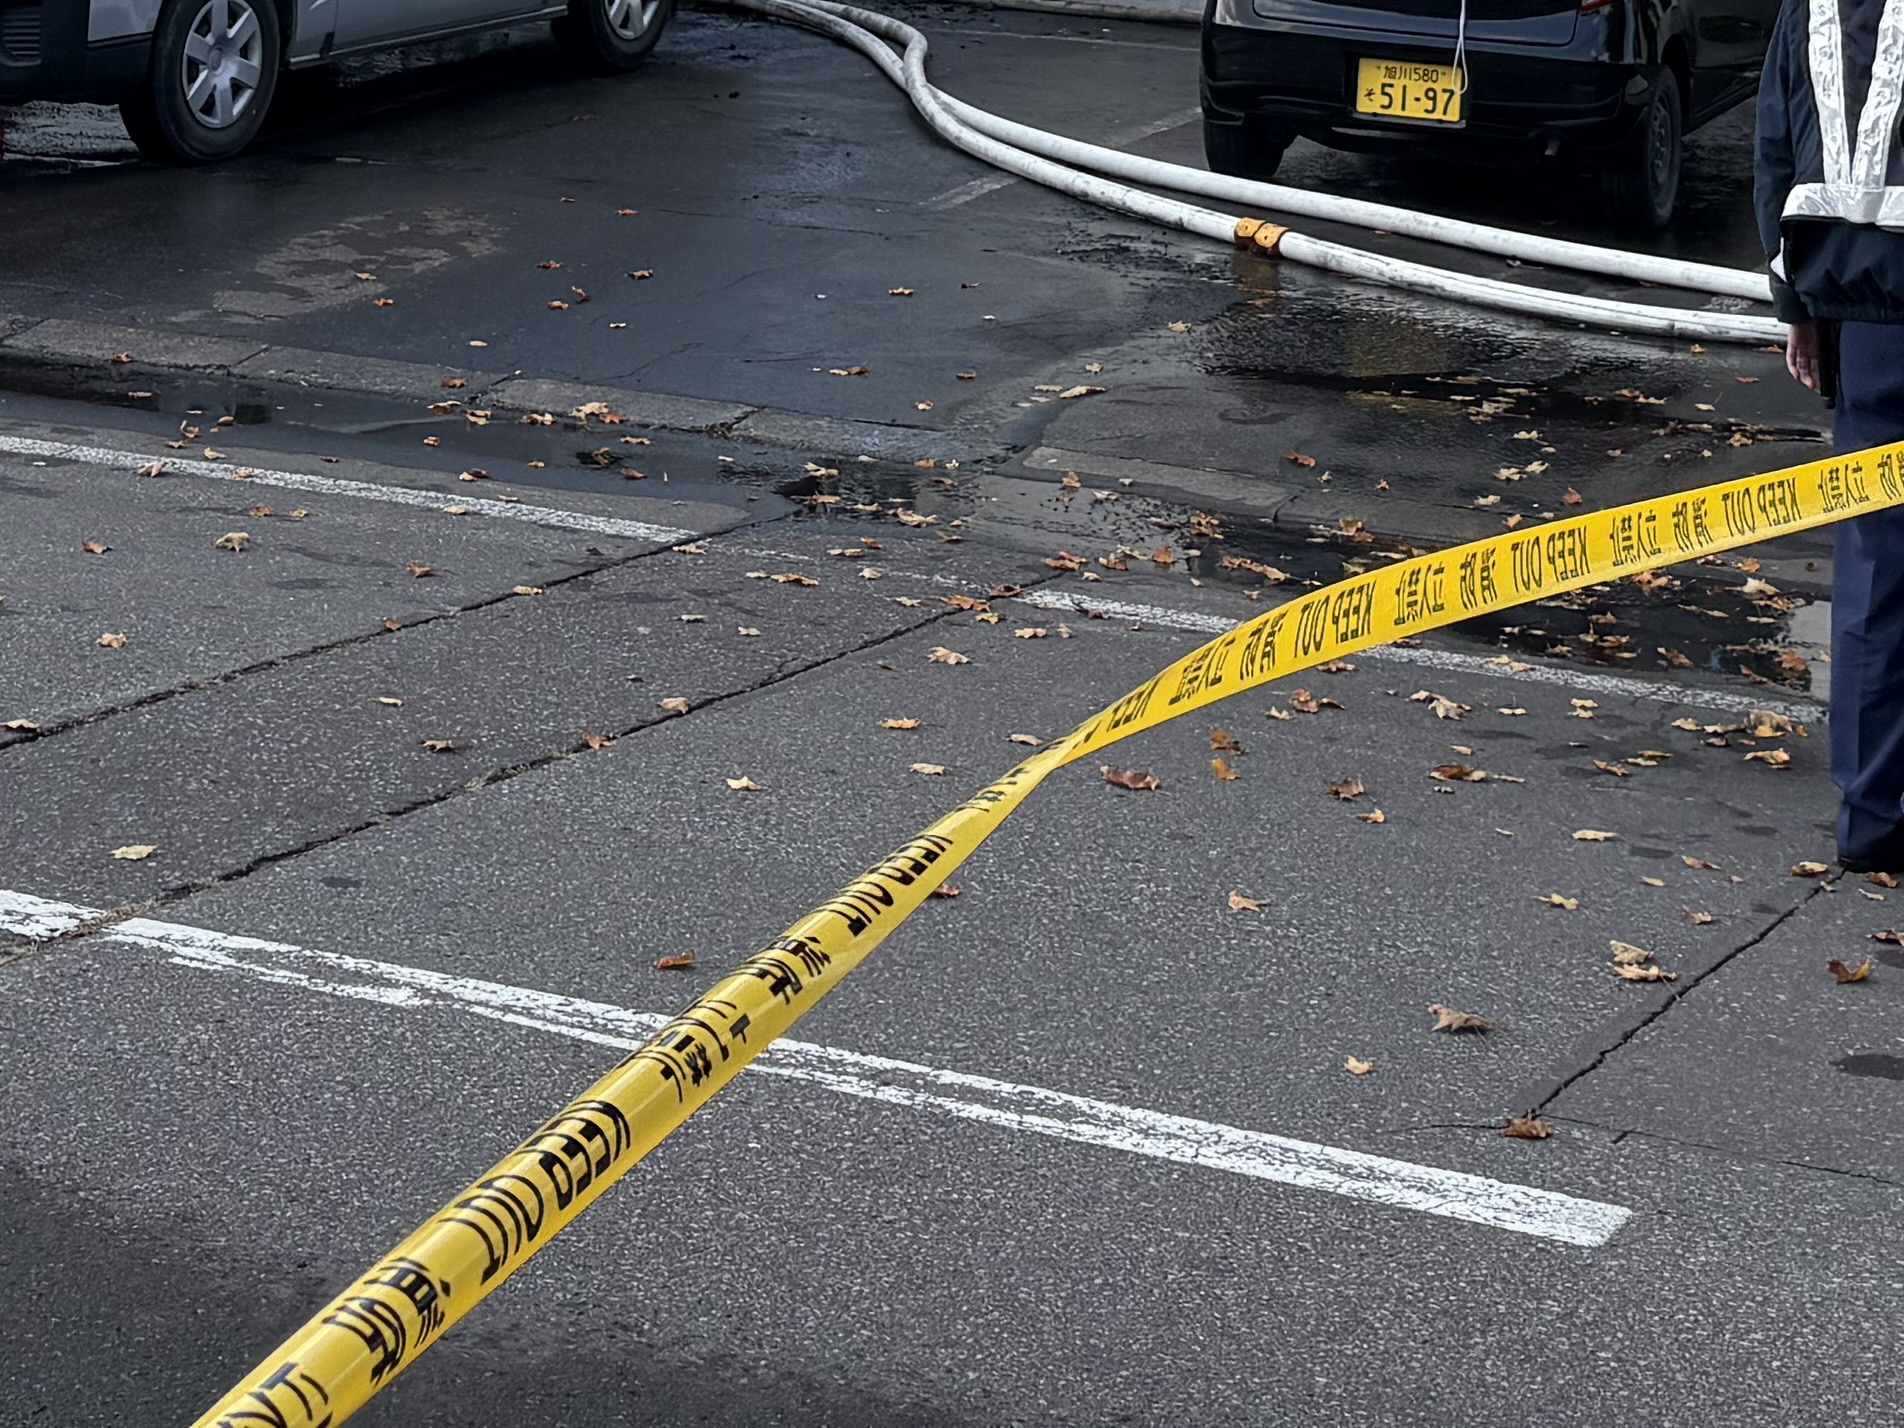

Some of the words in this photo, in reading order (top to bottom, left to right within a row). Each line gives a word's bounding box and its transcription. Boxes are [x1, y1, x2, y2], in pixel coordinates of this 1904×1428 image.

[1380, 83, 1456, 116] 51-97
[1383, 65, 1440, 83] 旭川580
[809, 881, 895, 938] OUT
[614, 998, 752, 1104] 立入禁止
[514, 1100, 631, 1211] KEEP
[436, 1174, 545, 1286] OUT
[321, 1257, 451, 1388] 消防
